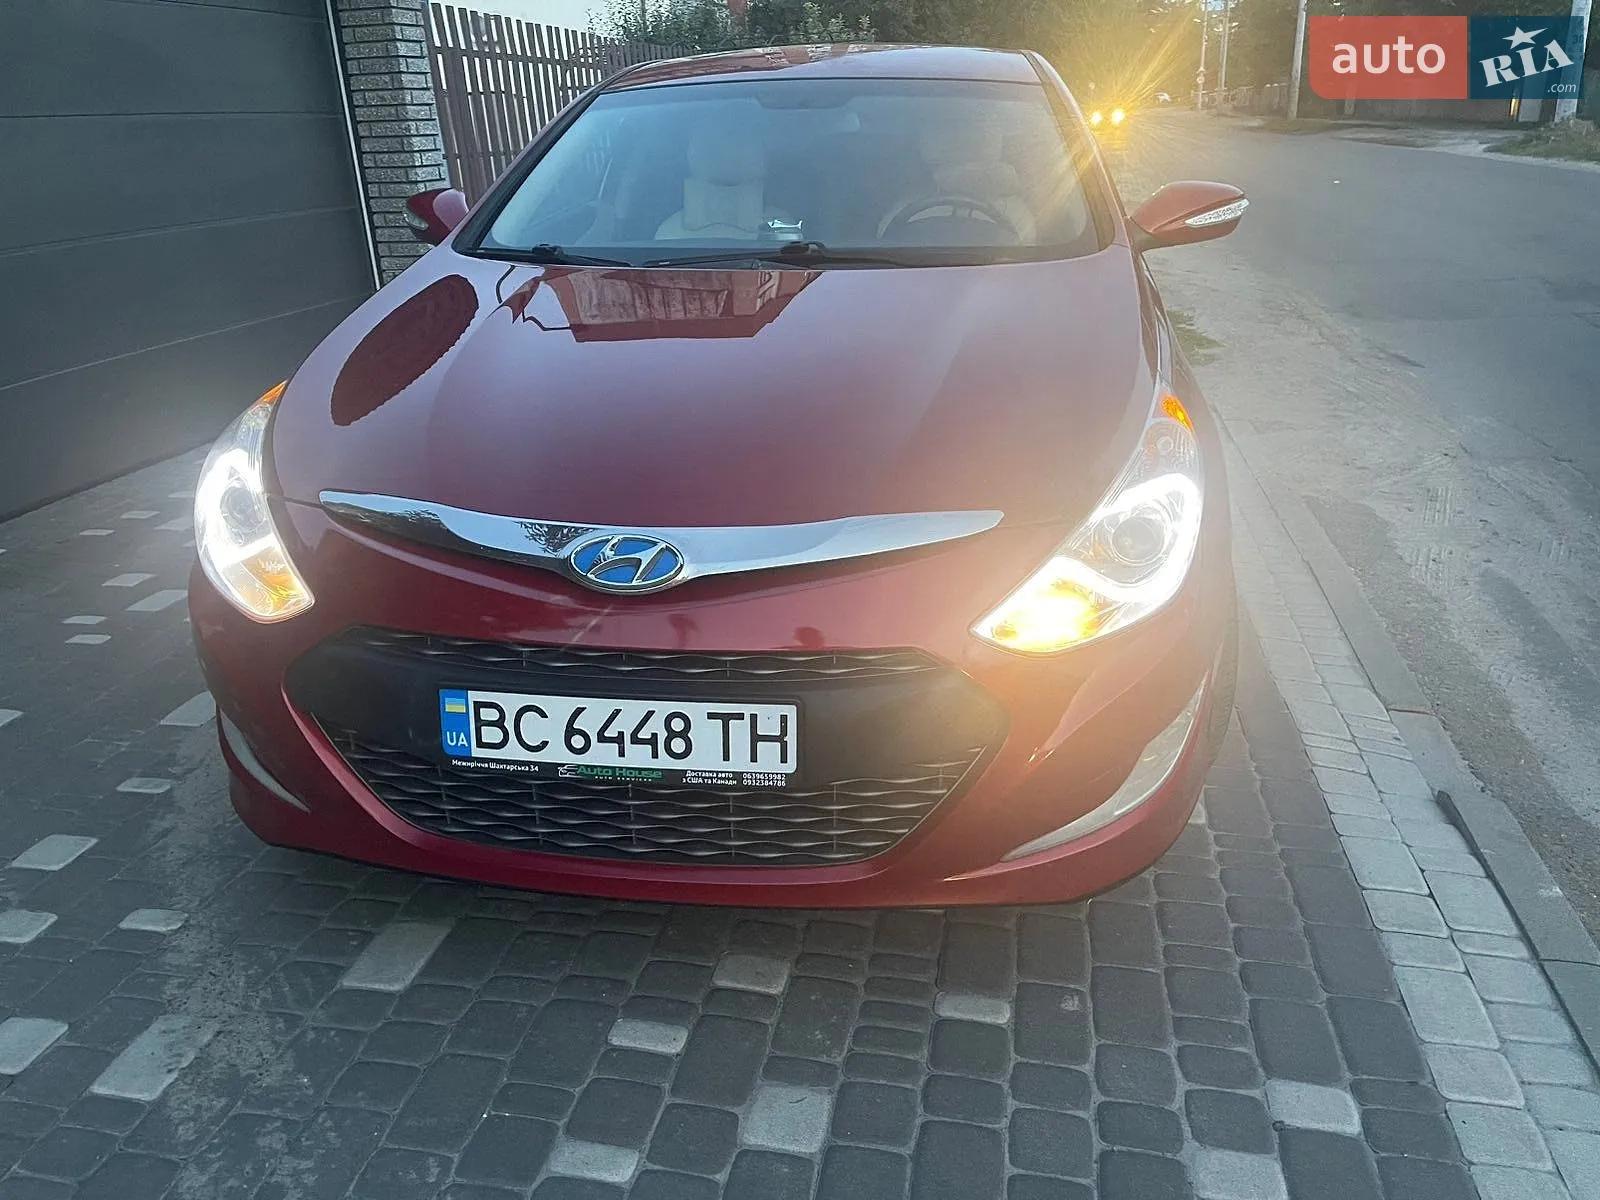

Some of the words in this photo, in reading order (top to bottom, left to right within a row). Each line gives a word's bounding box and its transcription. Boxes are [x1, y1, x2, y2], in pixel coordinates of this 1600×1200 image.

[472, 700, 550, 753] BC
[563, 706, 694, 761] 6448
[706, 711, 789, 765] TH
[446, 731, 469, 748] UA
[451, 759, 489, 769] Межиріччя
[489, 761, 529, 772] Шахтарська
[529, 764, 539, 772] 34
[577, 765, 612, 776] Auto
[615, 767, 662, 779] House
[685, 770, 717, 778] Доставка
[687, 776, 704, 784] США
[712, 778, 737, 786] Канади
